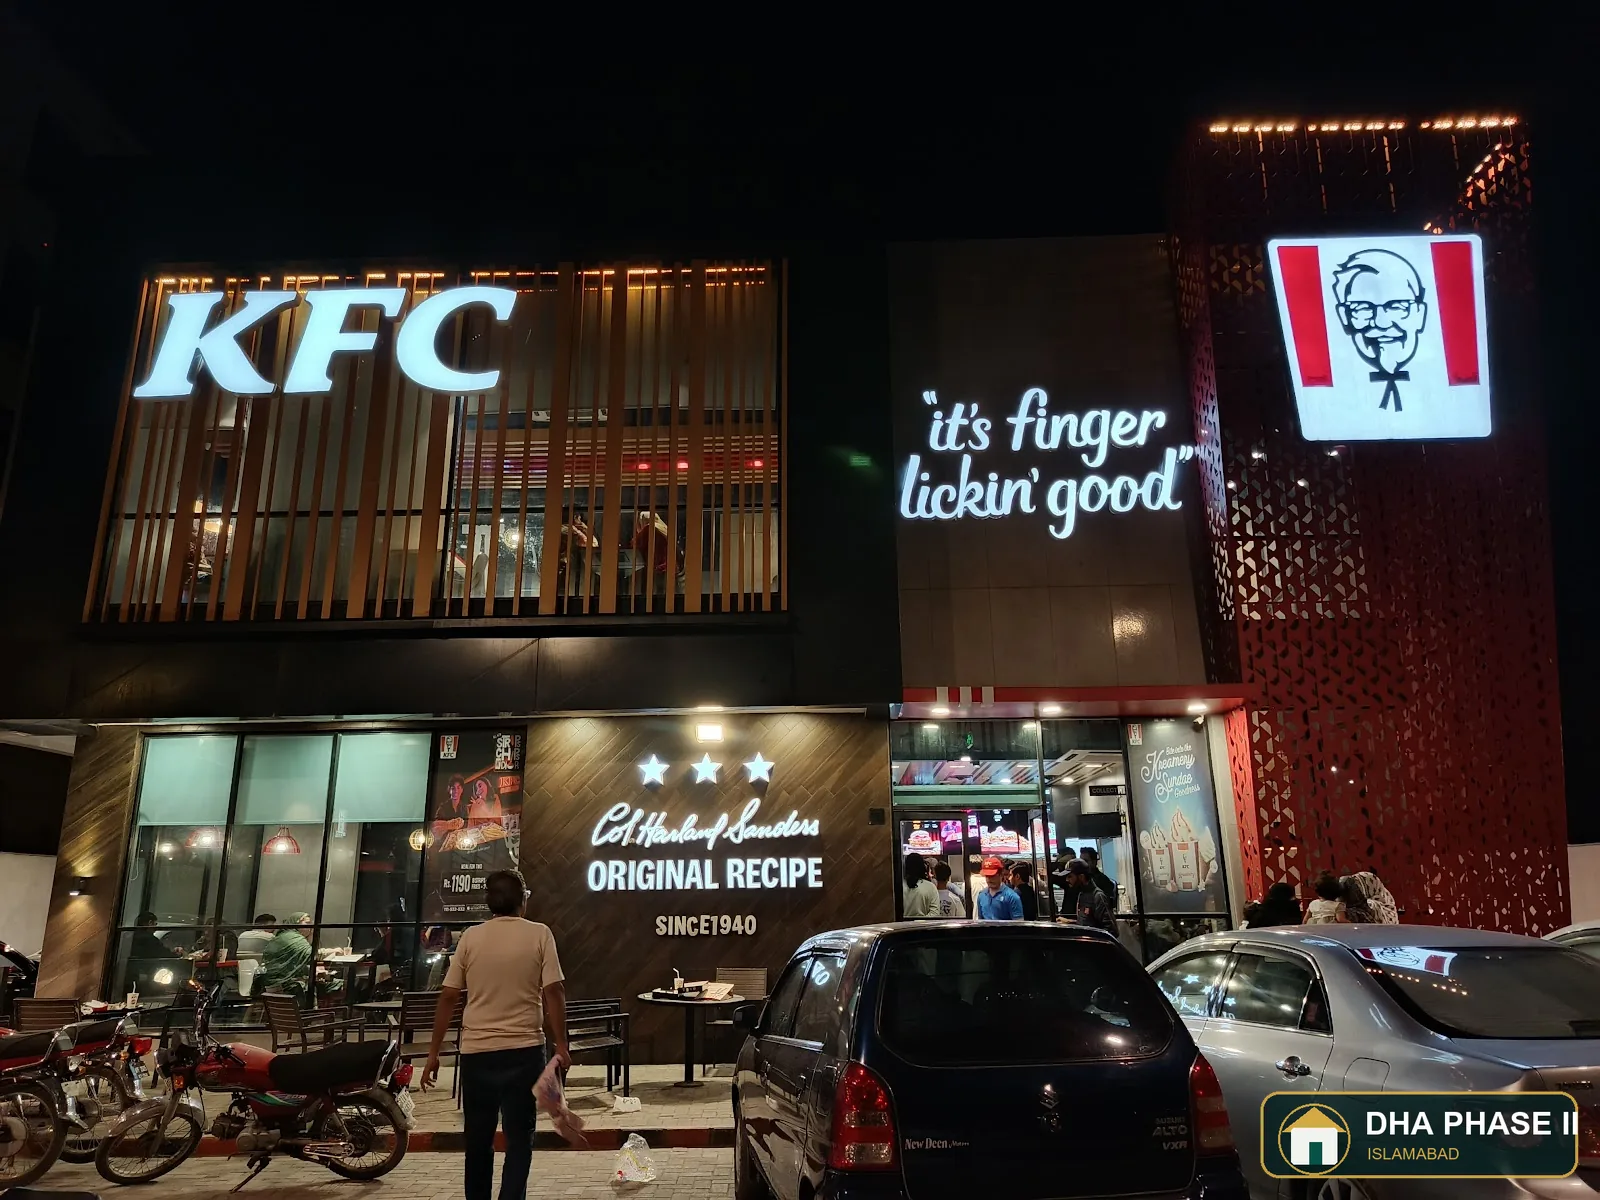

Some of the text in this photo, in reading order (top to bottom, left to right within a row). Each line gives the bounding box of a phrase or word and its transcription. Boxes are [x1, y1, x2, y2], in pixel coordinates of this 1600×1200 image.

[133, 285, 516, 398] KFC
[1006, 387, 1167, 468] finger
[900, 454, 1040, 520] lickin'
[1141, 750, 1195, 783] Kreamery
[1155, 772, 1192, 803] Sundae
[1174, 784, 1201, 798] Goodness
[635, 811, 729, 851] Harland
[722, 797, 820, 844] Sanders
[451, 875, 471, 892] 1190
[587, 857, 824, 891] ORIGINAL RECIPE
[904, 1138, 924, 1150] New
[925, 1137, 948, 1150] Deen
[1152, 1125, 1188, 1137] ALTO
[1162, 1140, 1188, 1150] VXR
